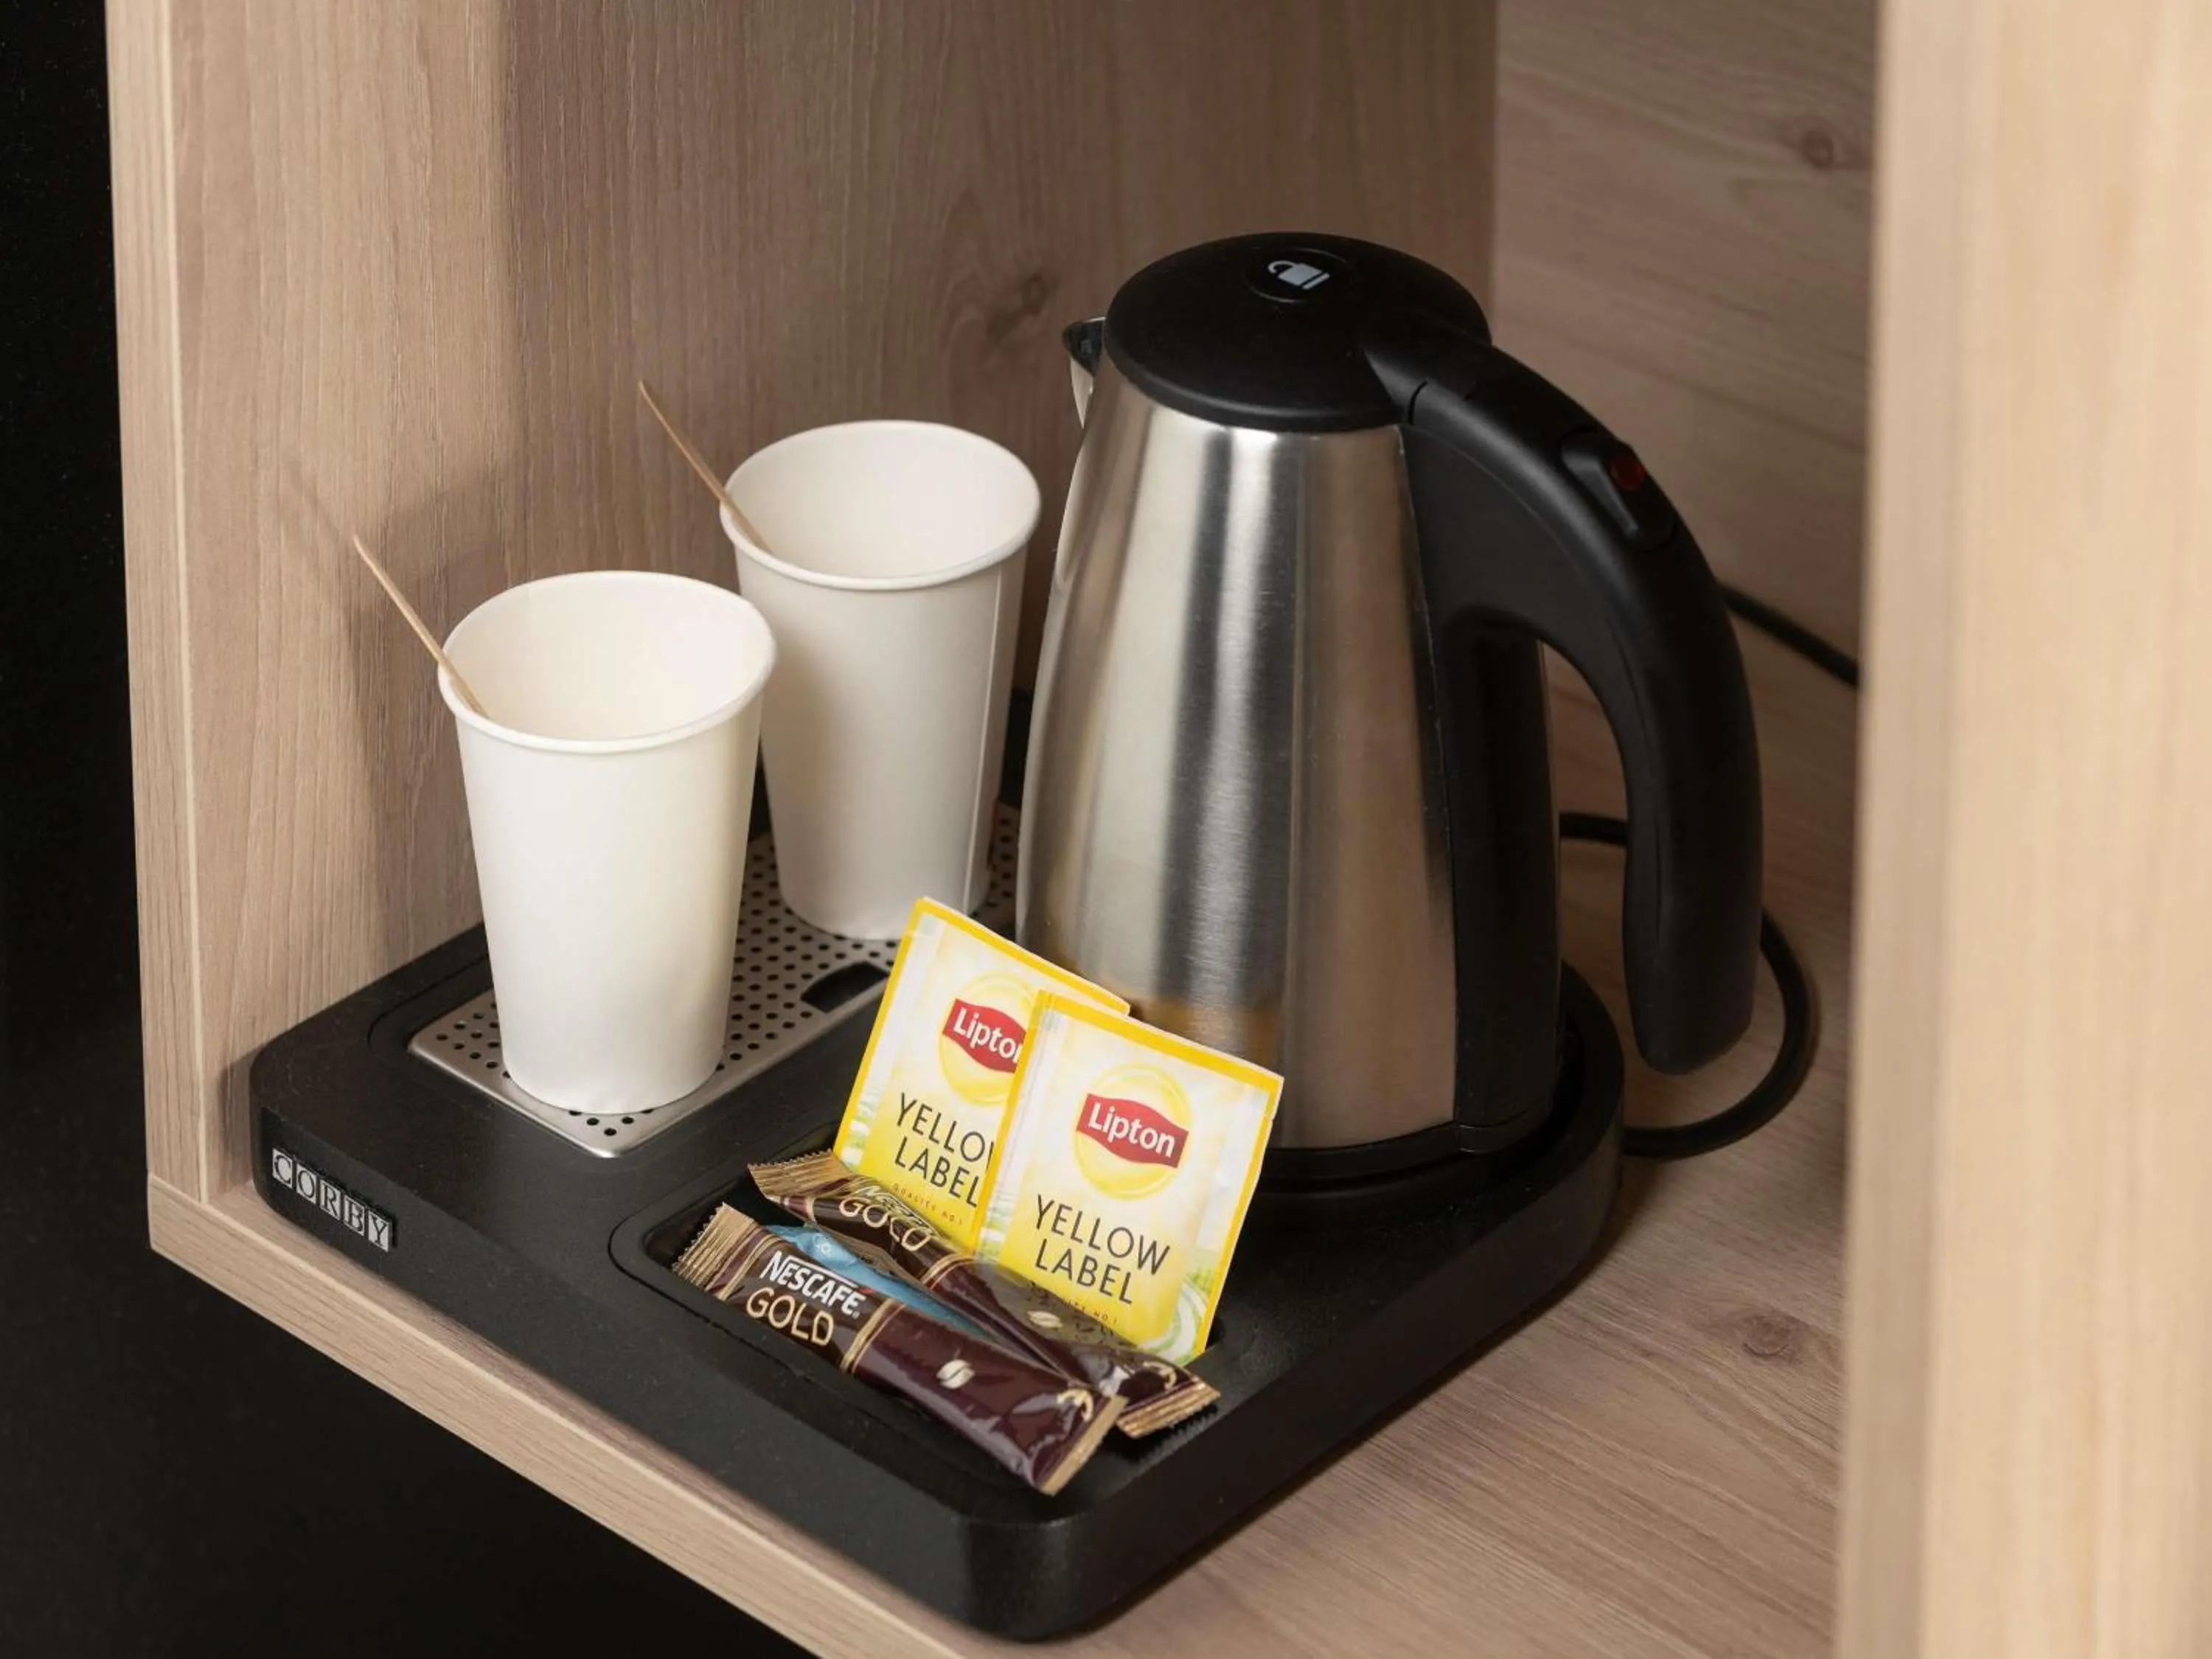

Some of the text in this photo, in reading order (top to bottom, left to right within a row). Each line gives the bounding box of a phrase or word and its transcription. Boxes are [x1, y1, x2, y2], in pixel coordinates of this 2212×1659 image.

[897, 1092, 994, 1173] YELLO
[1088, 1102, 1176, 1158] Lipton
[271, 1147, 390, 1252] CORBY
[894, 1136, 978, 1209] LABEL
[1034, 1193, 1171, 1276] YELLOW
[1034, 1238, 1133, 1305] LABEL
[746, 1287, 835, 1346] GOLD
